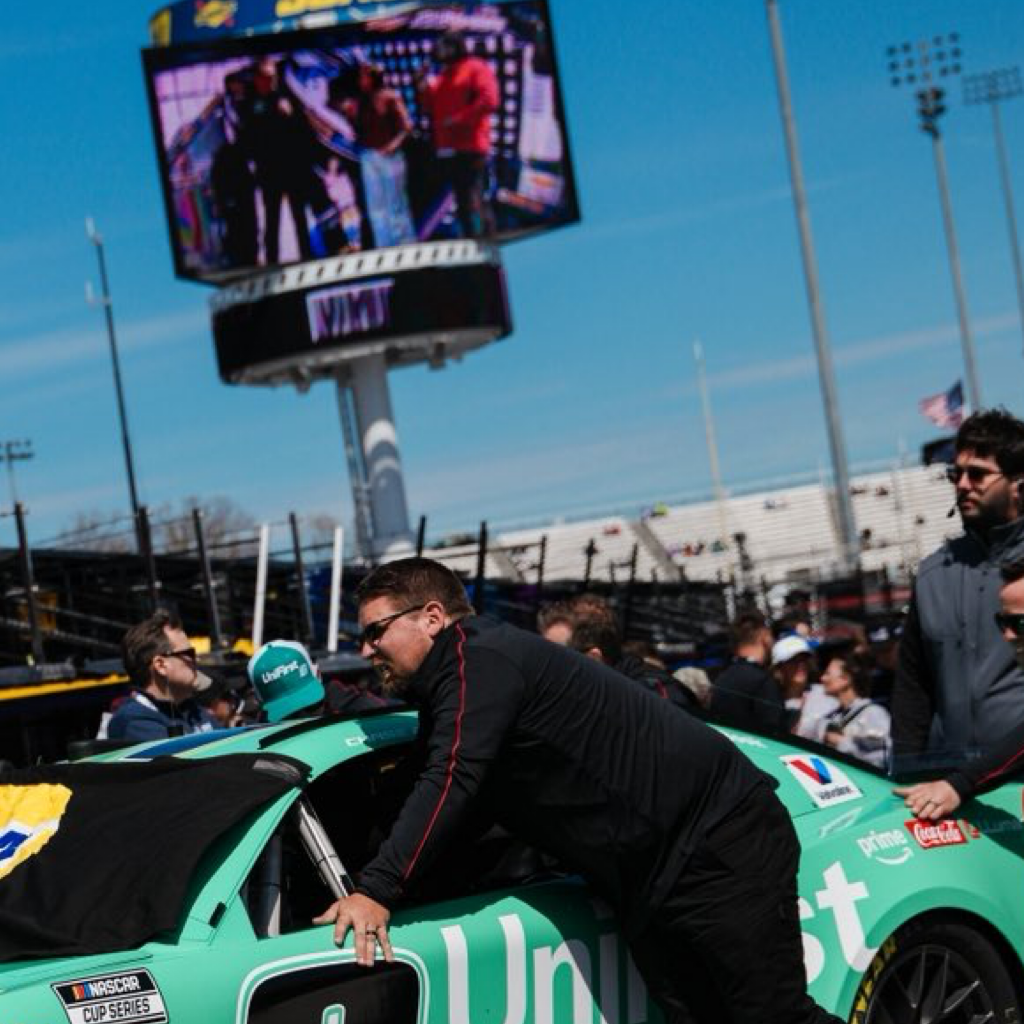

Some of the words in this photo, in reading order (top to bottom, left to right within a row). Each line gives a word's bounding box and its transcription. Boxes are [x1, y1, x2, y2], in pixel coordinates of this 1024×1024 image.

[856, 829, 908, 858] prime
[88, 975, 141, 998] NASCAR
[82, 1005, 108, 1022] CUP
[108, 998, 151, 1019] SERIES
